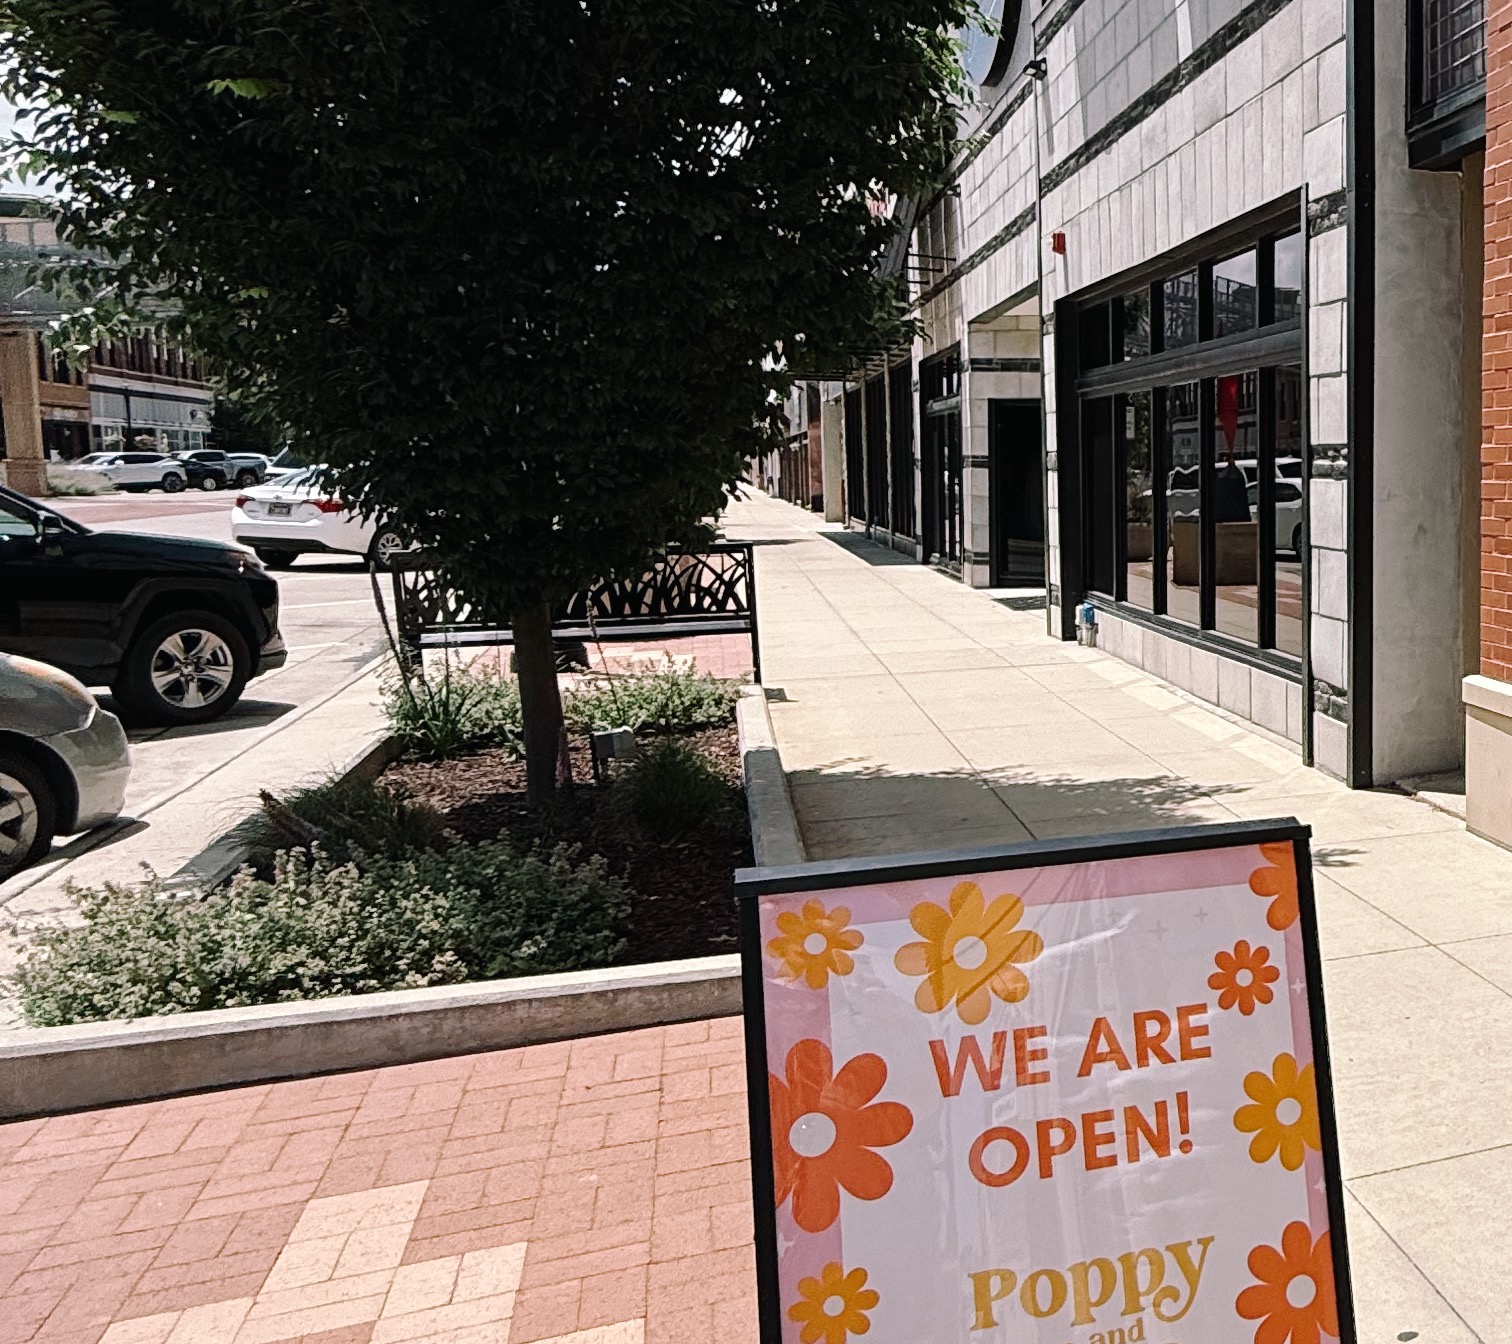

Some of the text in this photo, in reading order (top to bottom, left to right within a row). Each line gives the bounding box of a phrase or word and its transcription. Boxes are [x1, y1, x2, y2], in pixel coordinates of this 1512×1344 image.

[929, 1003, 1212, 1097] WE ARE
[969, 1091, 1193, 1187] OPEN!
[967, 1235, 1215, 1332] Poppy
